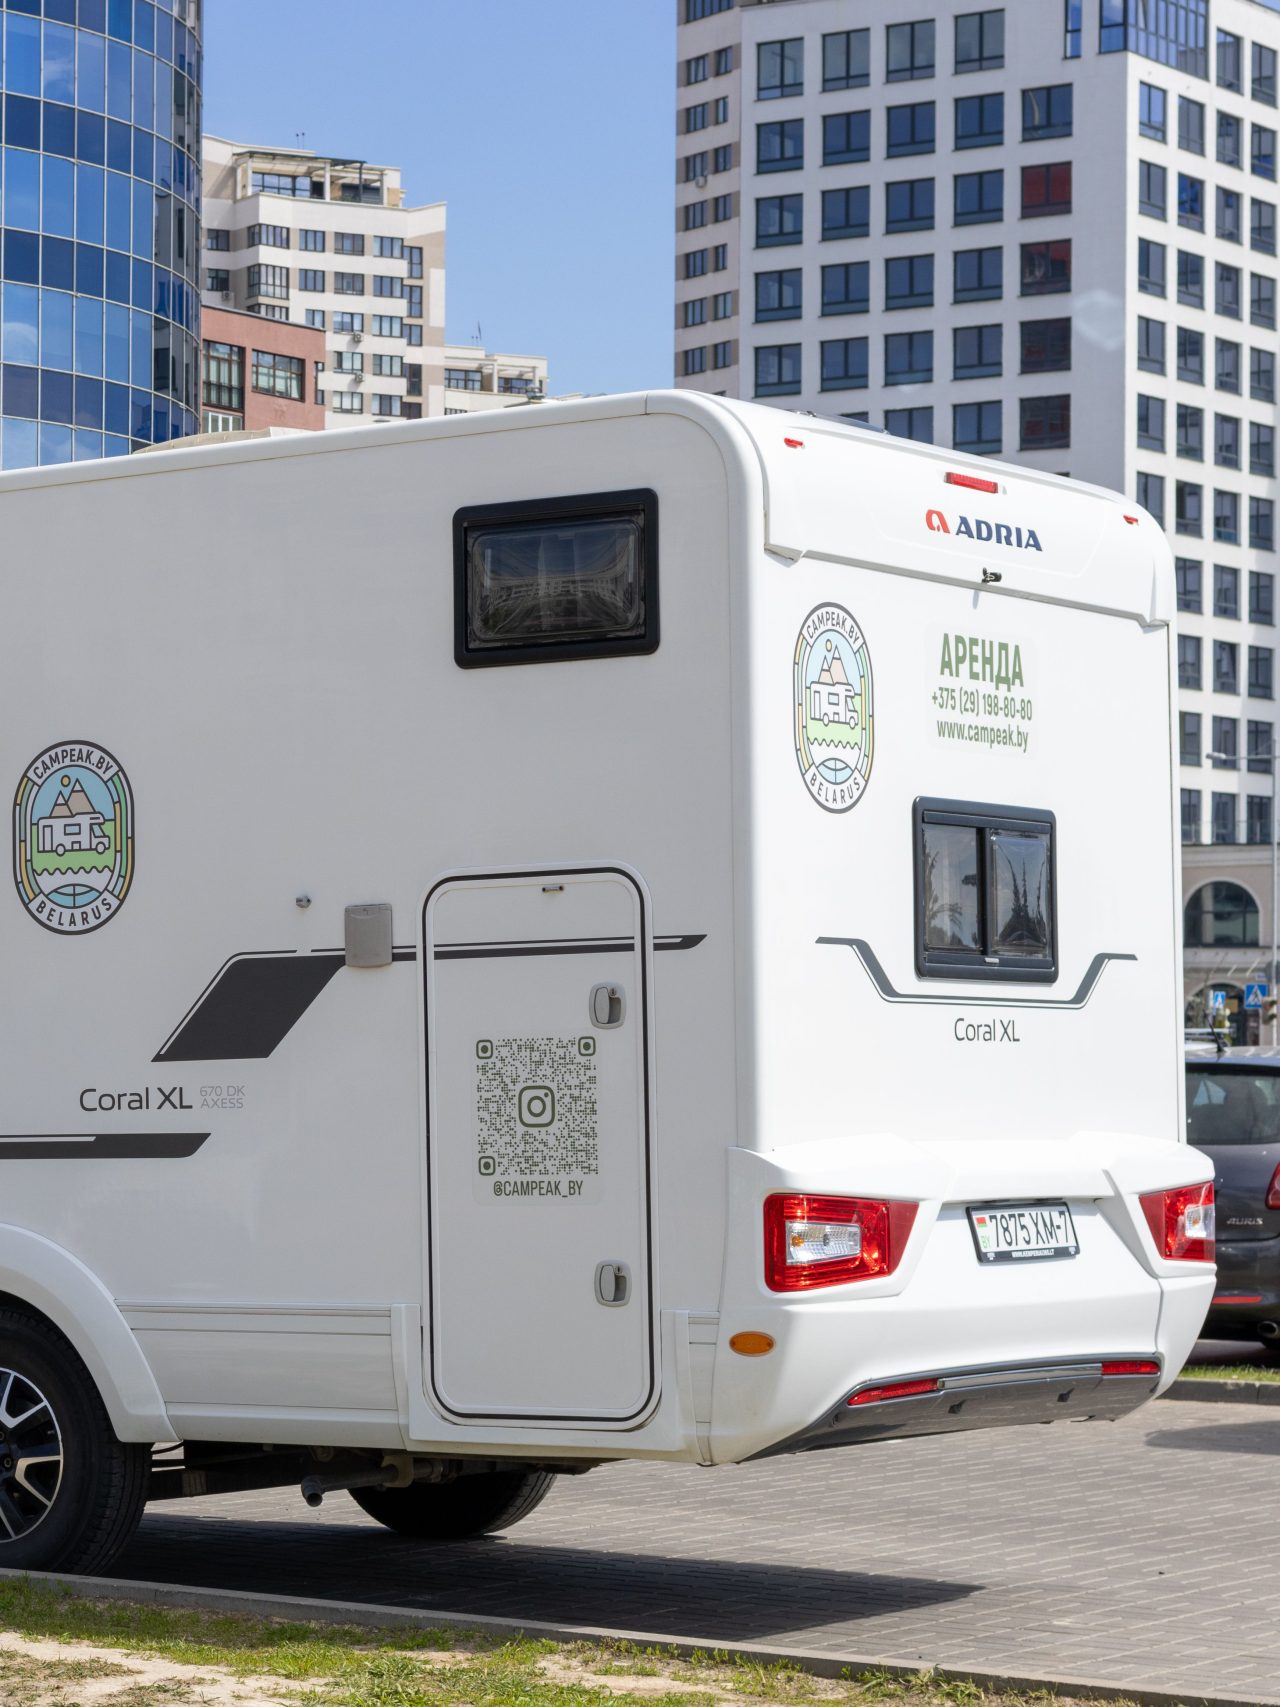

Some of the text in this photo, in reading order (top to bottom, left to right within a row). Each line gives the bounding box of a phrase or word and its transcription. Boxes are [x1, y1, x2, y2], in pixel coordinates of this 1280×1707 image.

[955, 515, 1043, 552] ADRIA
[806, 611, 860, 645] CAMPEAK.BY
[940, 632, 1024, 692] АРЕНДА
[932, 686, 1032, 721] +375 (29) 198-80-80
[937, 720, 1028, 753] www.campeak.by
[33, 748, 113, 780] CAMPEAK.BY
[810, 772, 861, 804] BELARUS
[36, 897, 112, 927] BELARUS
[954, 1017, 1020, 1042] Coral XL
[79, 1086, 193, 1112] Coral XL
[200, 1085, 246, 1097] 670 DK
[200, 1097, 244, 1109] AXESS
[493, 1180, 583, 1198] @CAMPEAK_BY
